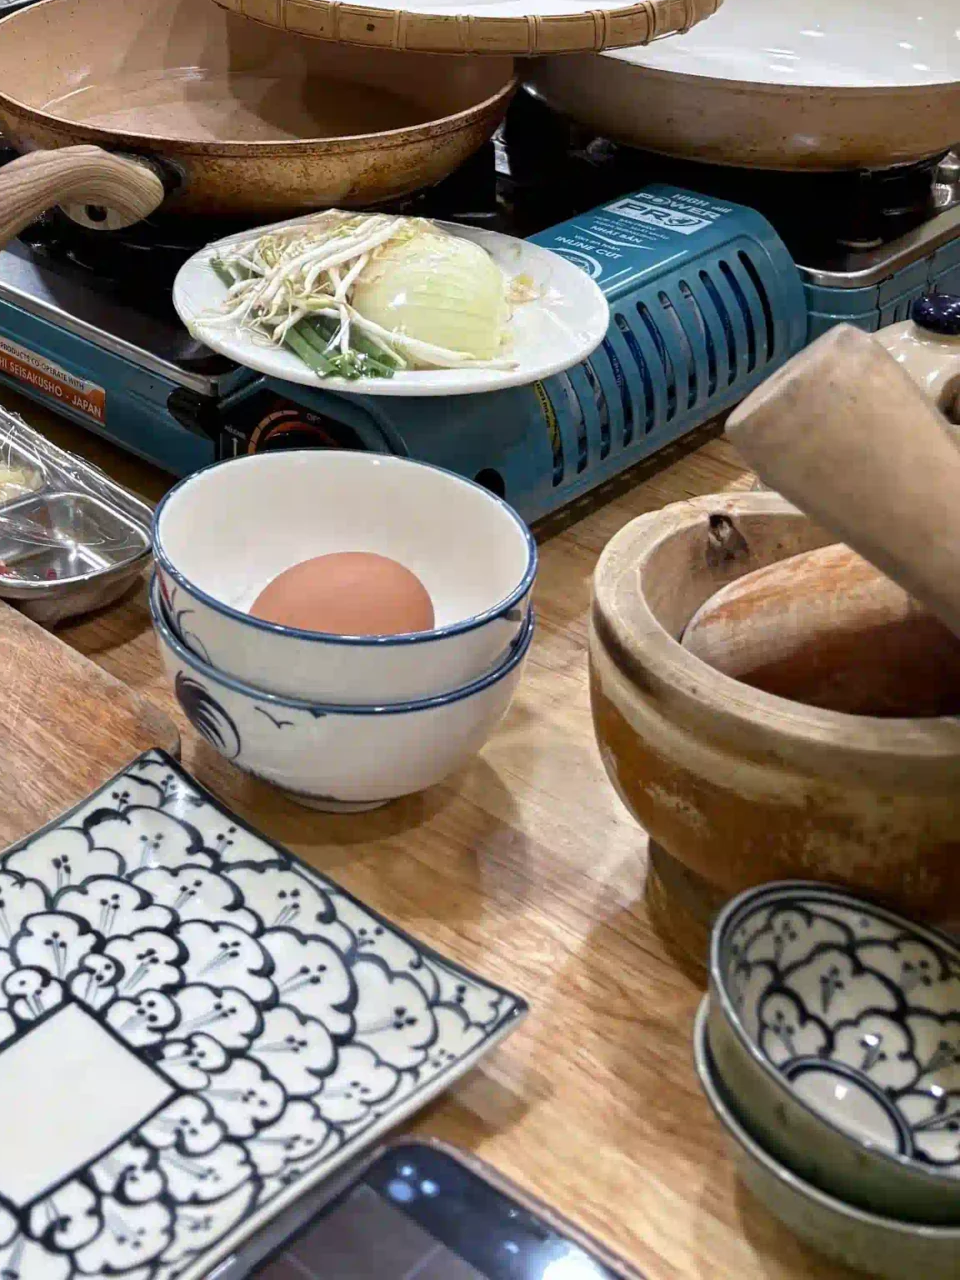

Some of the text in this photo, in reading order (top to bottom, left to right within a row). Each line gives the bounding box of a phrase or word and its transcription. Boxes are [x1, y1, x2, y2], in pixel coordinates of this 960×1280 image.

[635, 192, 722, 219] POWER
[671, 193, 710, 207] HIGH
[554, 236, 623, 259] INLINE CUT
[0, 341, 30, 364] PRODUCTS
[68, 375, 85, 391] WITH
[9, 361, 63, 399] SEISAKUSHO
[71, 393, 103, 418] JAPAN
